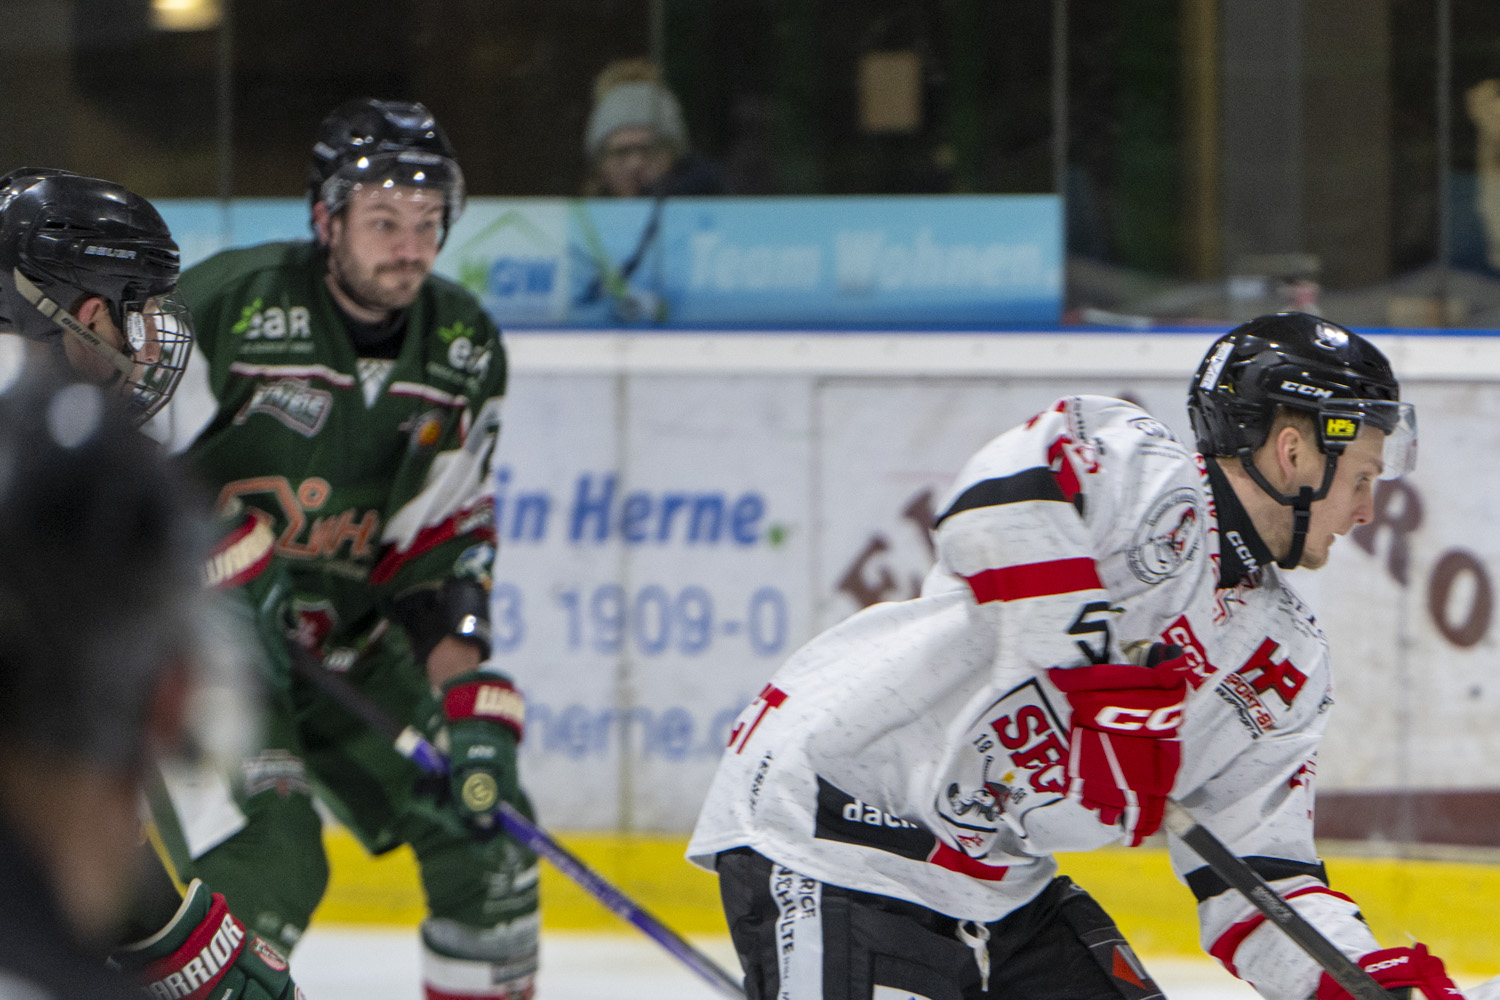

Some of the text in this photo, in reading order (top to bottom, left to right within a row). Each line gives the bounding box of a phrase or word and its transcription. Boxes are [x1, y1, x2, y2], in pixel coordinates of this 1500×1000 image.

[61, 316, 101, 347] BAUER
[1280, 380, 1334, 399] CCM
[568, 470, 788, 547] Herne.
[1226, 530, 1261, 574] CCM
[558, 585, 790, 657] 1909-0
[1364, 955, 1410, 974] CCM
